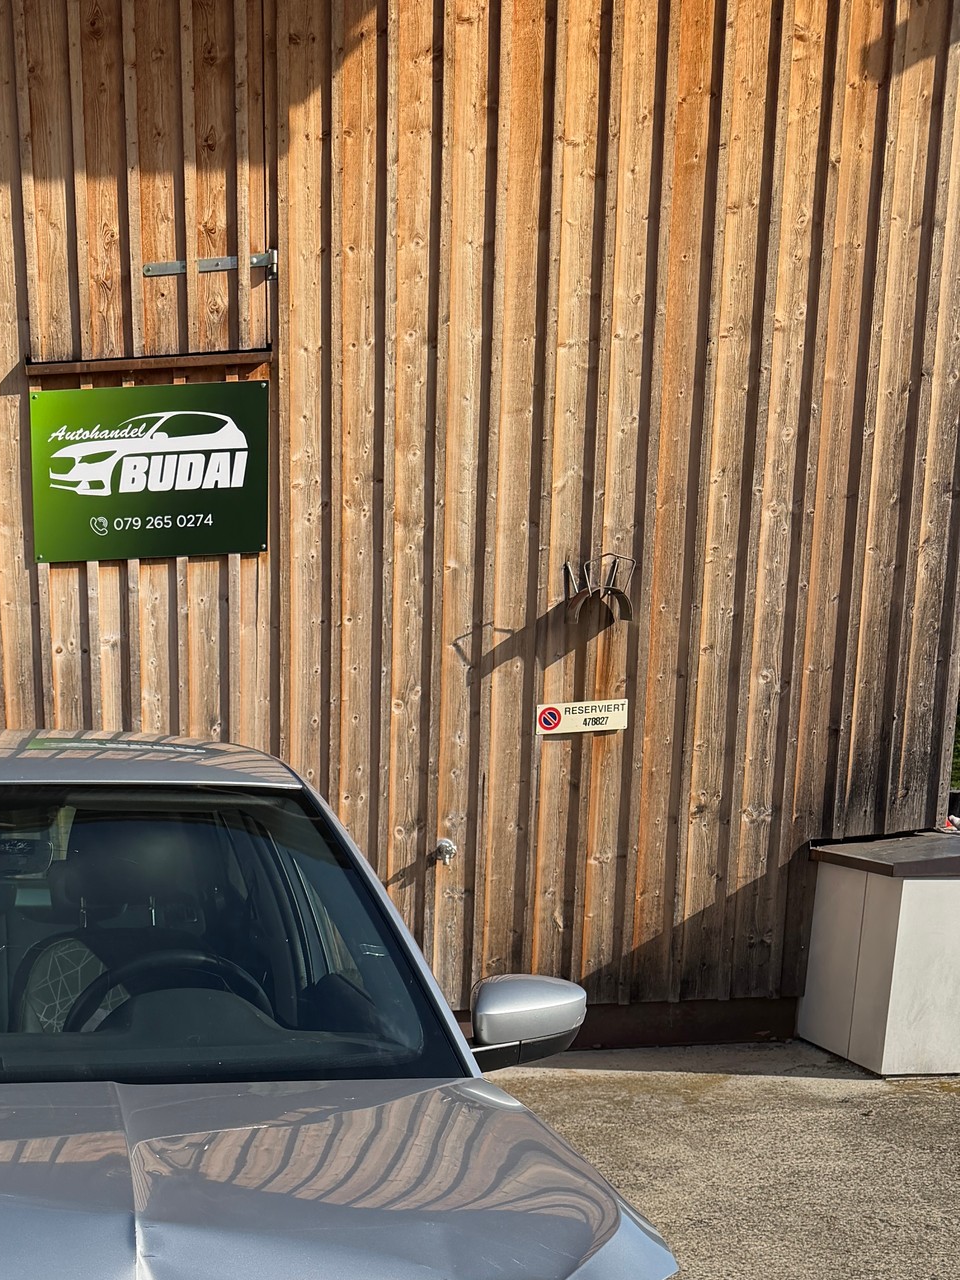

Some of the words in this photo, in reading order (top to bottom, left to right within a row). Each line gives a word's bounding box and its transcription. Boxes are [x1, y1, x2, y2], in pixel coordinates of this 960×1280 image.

[47, 422, 147, 443] Autohandel
[118, 451, 249, 494] BUDAI
[113, 516, 142, 531] 079
[145, 515, 173, 530] 265
[176, 513, 214, 528] 0274
[564, 703, 626, 715] RESERVIERT
